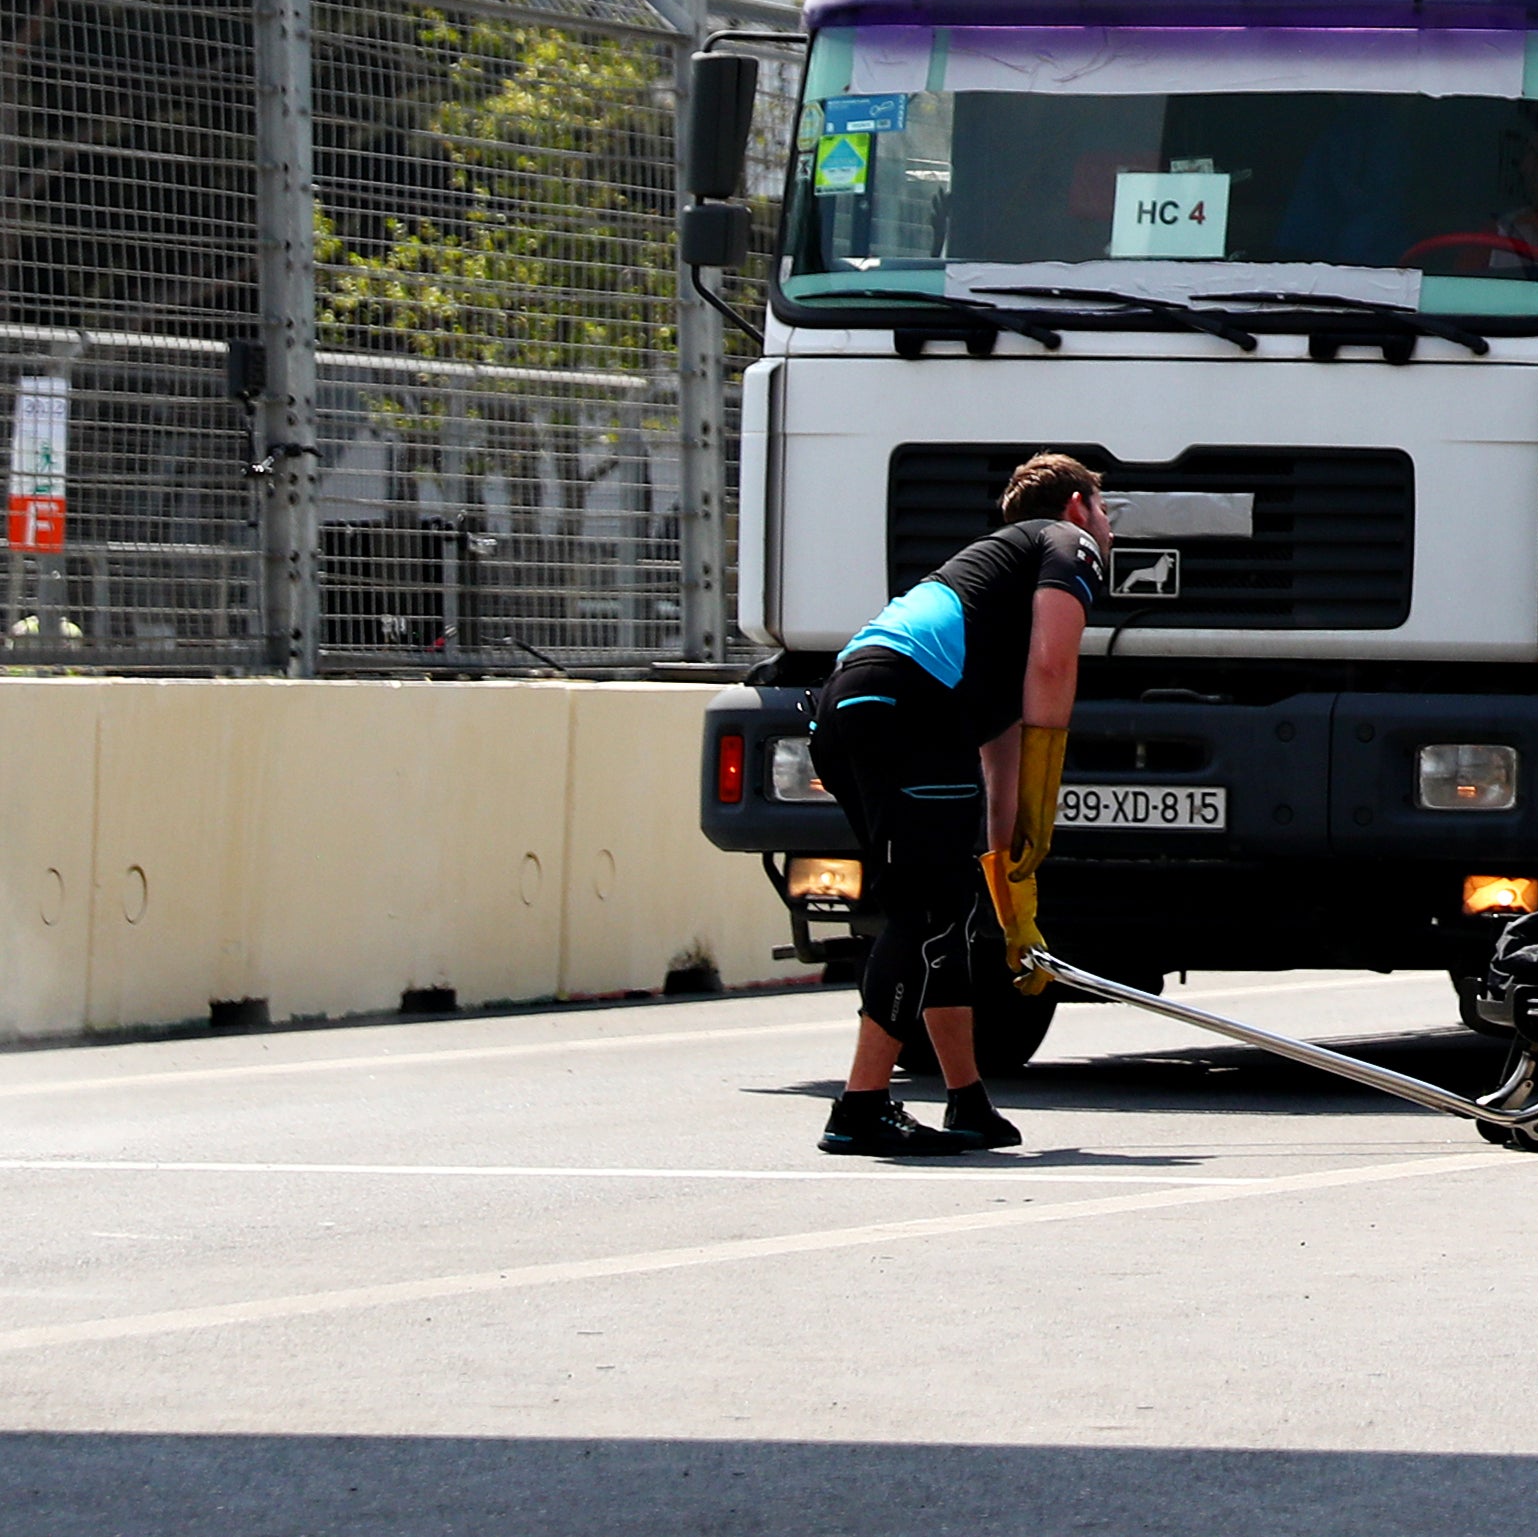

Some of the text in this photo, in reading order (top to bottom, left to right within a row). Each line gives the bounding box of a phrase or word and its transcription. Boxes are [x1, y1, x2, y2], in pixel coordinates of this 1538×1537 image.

[1137, 199, 1207, 225] HC 4
[1062, 789, 1220, 825] 99-XD-815
